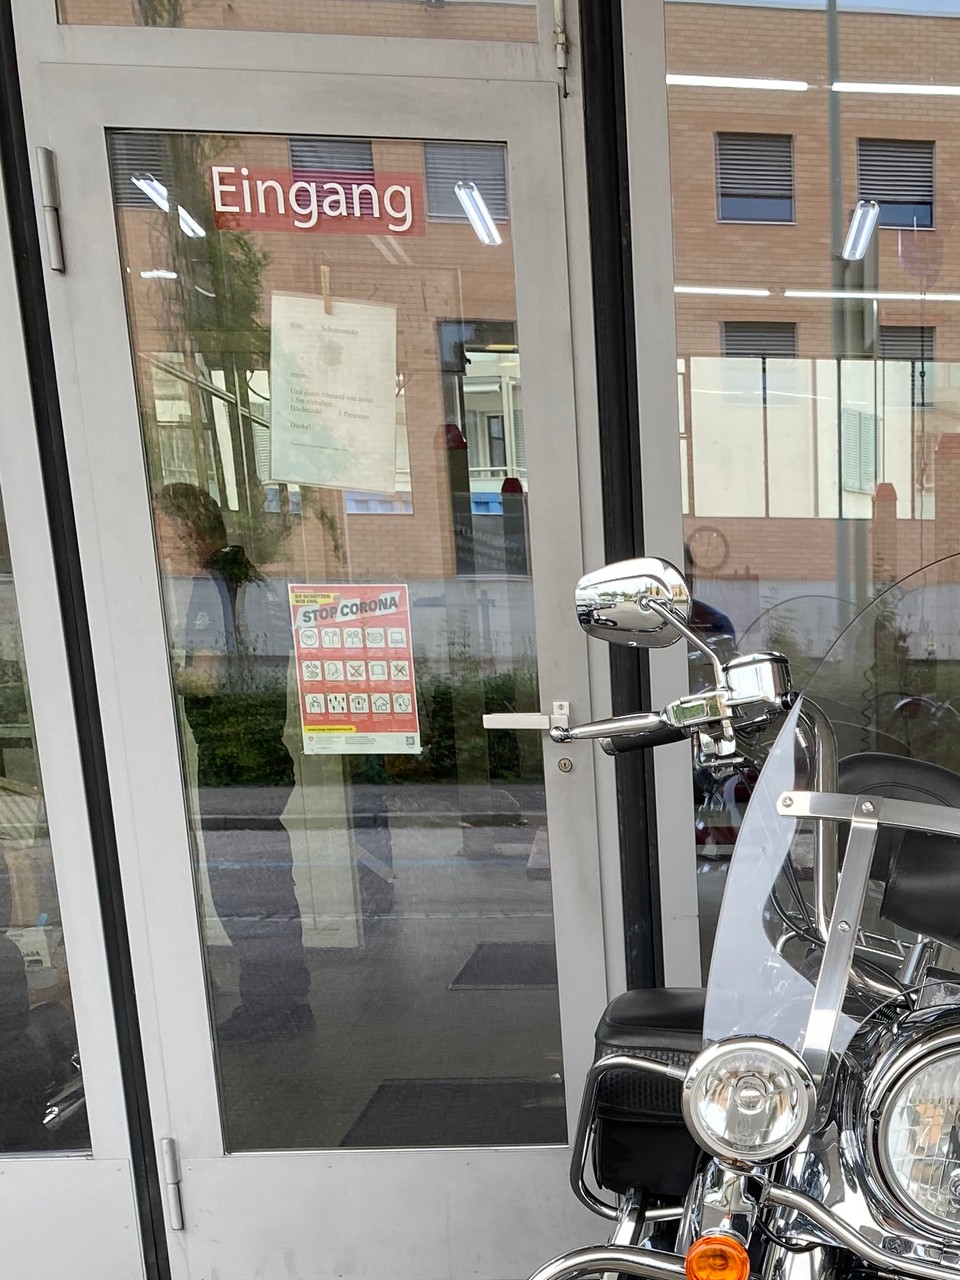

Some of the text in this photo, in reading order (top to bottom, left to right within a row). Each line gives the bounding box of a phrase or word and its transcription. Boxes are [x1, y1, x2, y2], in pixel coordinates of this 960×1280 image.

[211, 166, 413, 232] Eingang
[302, 596, 399, 624] STOP CORONA
